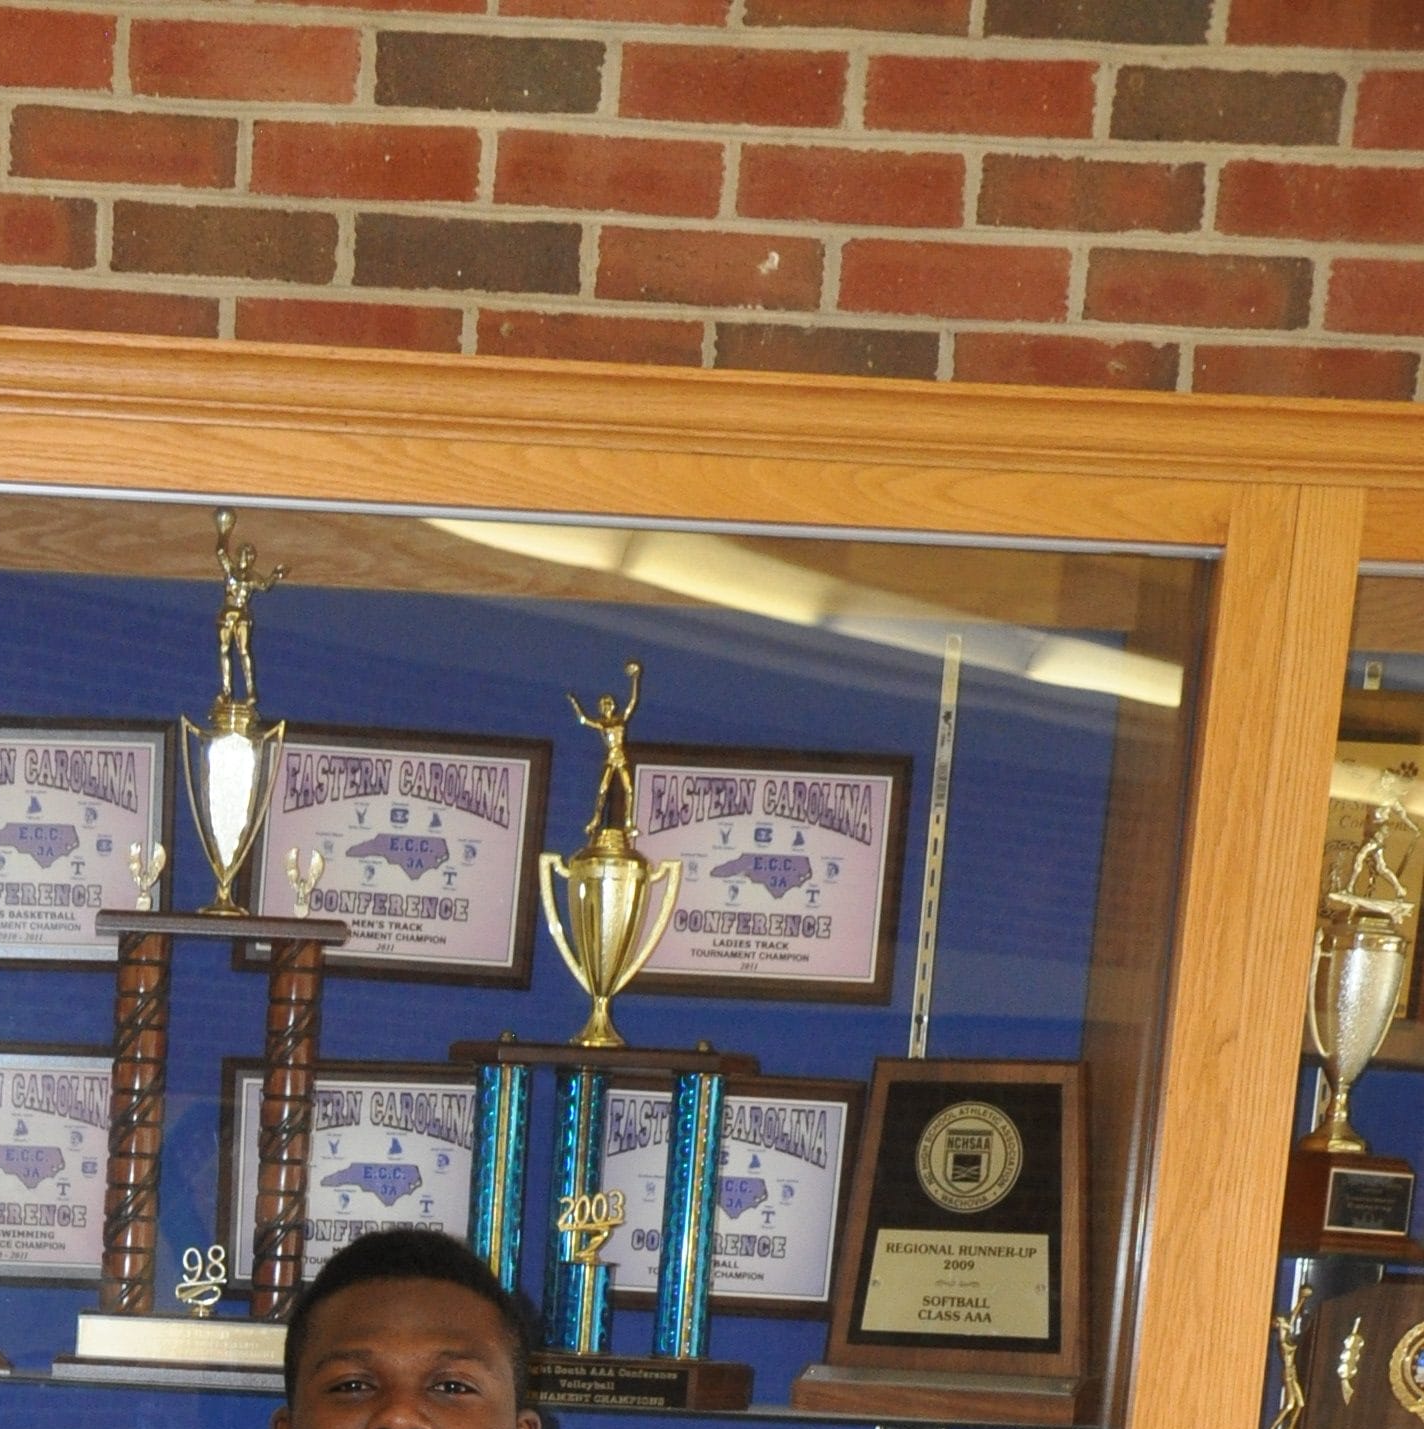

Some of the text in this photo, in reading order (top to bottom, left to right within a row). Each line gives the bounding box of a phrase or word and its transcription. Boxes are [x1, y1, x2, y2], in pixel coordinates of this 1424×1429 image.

[25, 748, 137, 813] CAROLINA
[283, 753, 509, 829] EASTERN CAROLINA
[648, 775, 872, 845] EASTERN CAROLINA
[309, 889, 469, 921] CONFERENCE
[9, 911, 76, 921] BASKETBALL
[30, 922, 81, 932] CHAMPION
[352, 919, 423, 932] MEN'S TRACK
[675, 909, 832, 939] CONFERENCE
[395, 932, 447, 944] CHAMPION
[712, 938, 789, 950] LADIES TRACK
[691, 949, 809, 962] TOURNAMENT CHAMPION
[12, 1074, 109, 1130] CAROLIN
[948, 1137, 991, 1149] NCHSAA
[558, 1190, 624, 1228] 2003
[15, 1240, 66, 1250] CHAMPION
[886, 1242, 1037, 1259] REGIONAL RUNNER-UP
[182, 1244, 226, 1282] 98
[944, 1259, 975, 1271] 2009
[714, 1270, 764, 1281] CHAMPION
[922, 1296, 991, 1309] SOFTBALL
[918, 1309, 992, 1323] CLASS AAA
